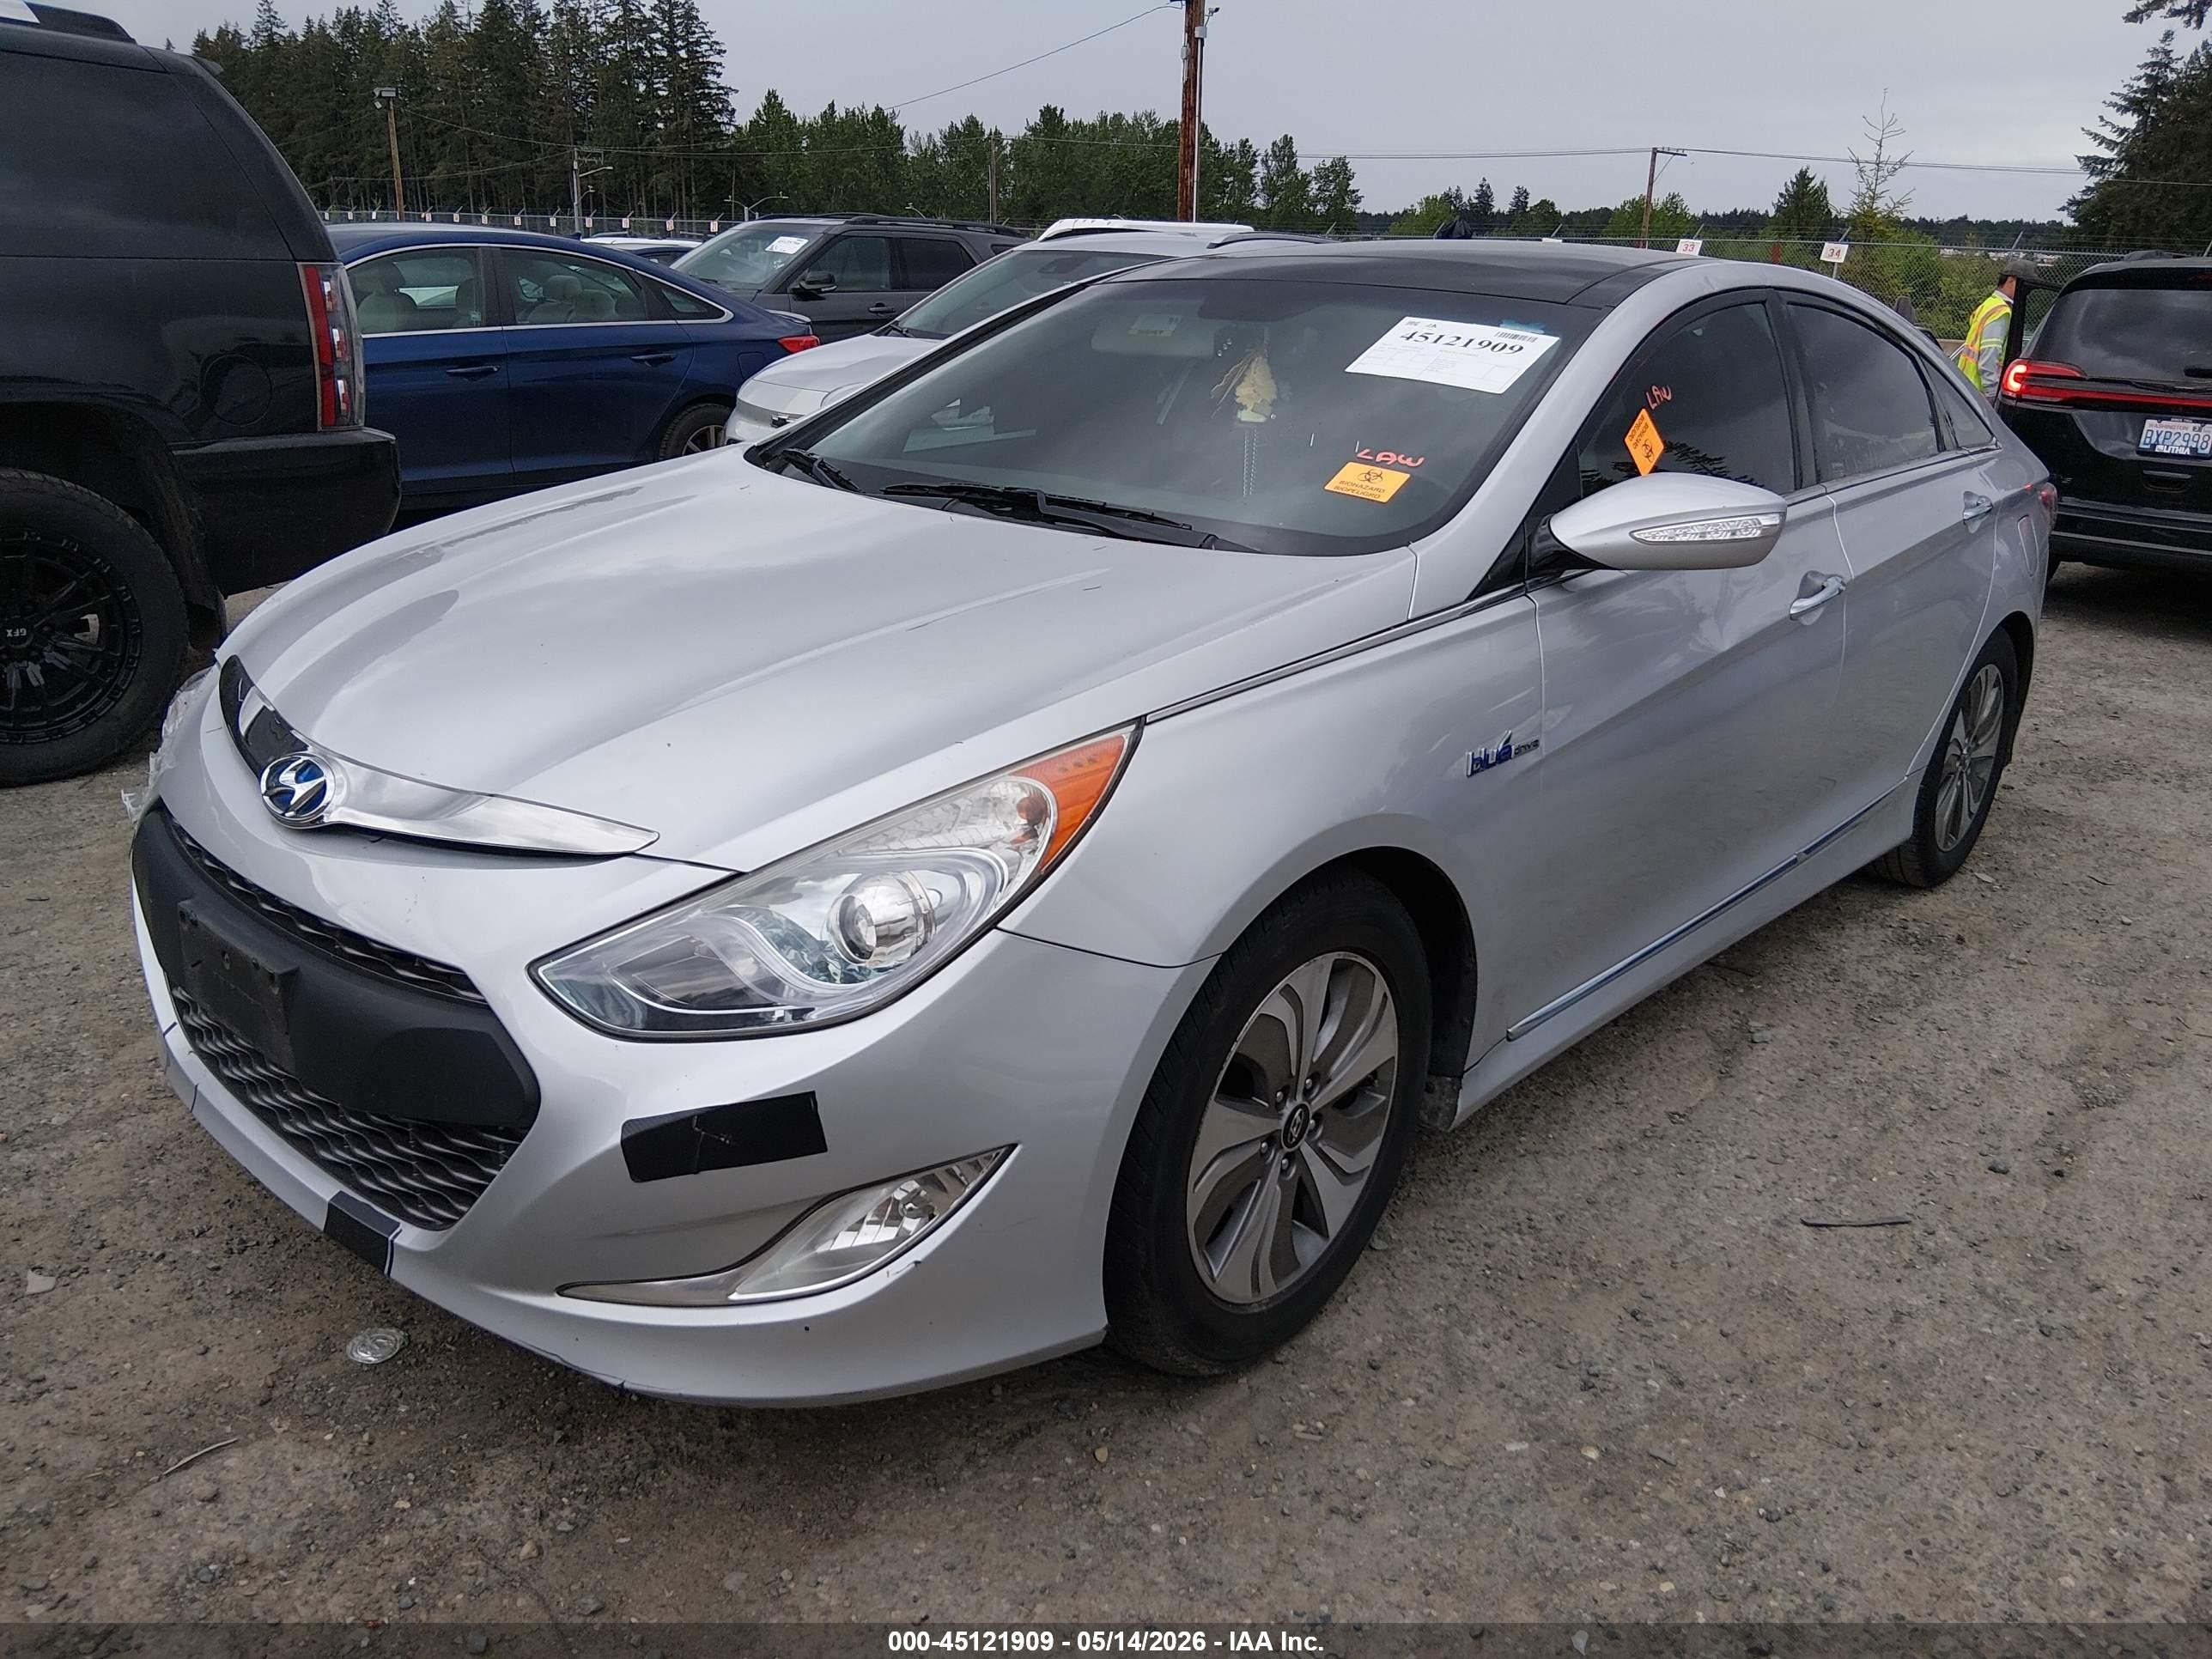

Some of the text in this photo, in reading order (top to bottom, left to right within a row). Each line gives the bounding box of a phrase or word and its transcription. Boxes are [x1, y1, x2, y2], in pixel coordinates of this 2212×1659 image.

[1682, 243, 1695, 252] 33
[1828, 248, 1841, 258] 34
[1401, 331, 1524, 355] 45121909
[2142, 429, 2211, 451] BXP2998
[2163, 445, 2191, 455] LITHIA
[1333, 485, 1382, 500] BIOPELIGRO
[1339, 480, 1386, 494] BIOHAZARD
[6, 628, 27, 638] GFX
